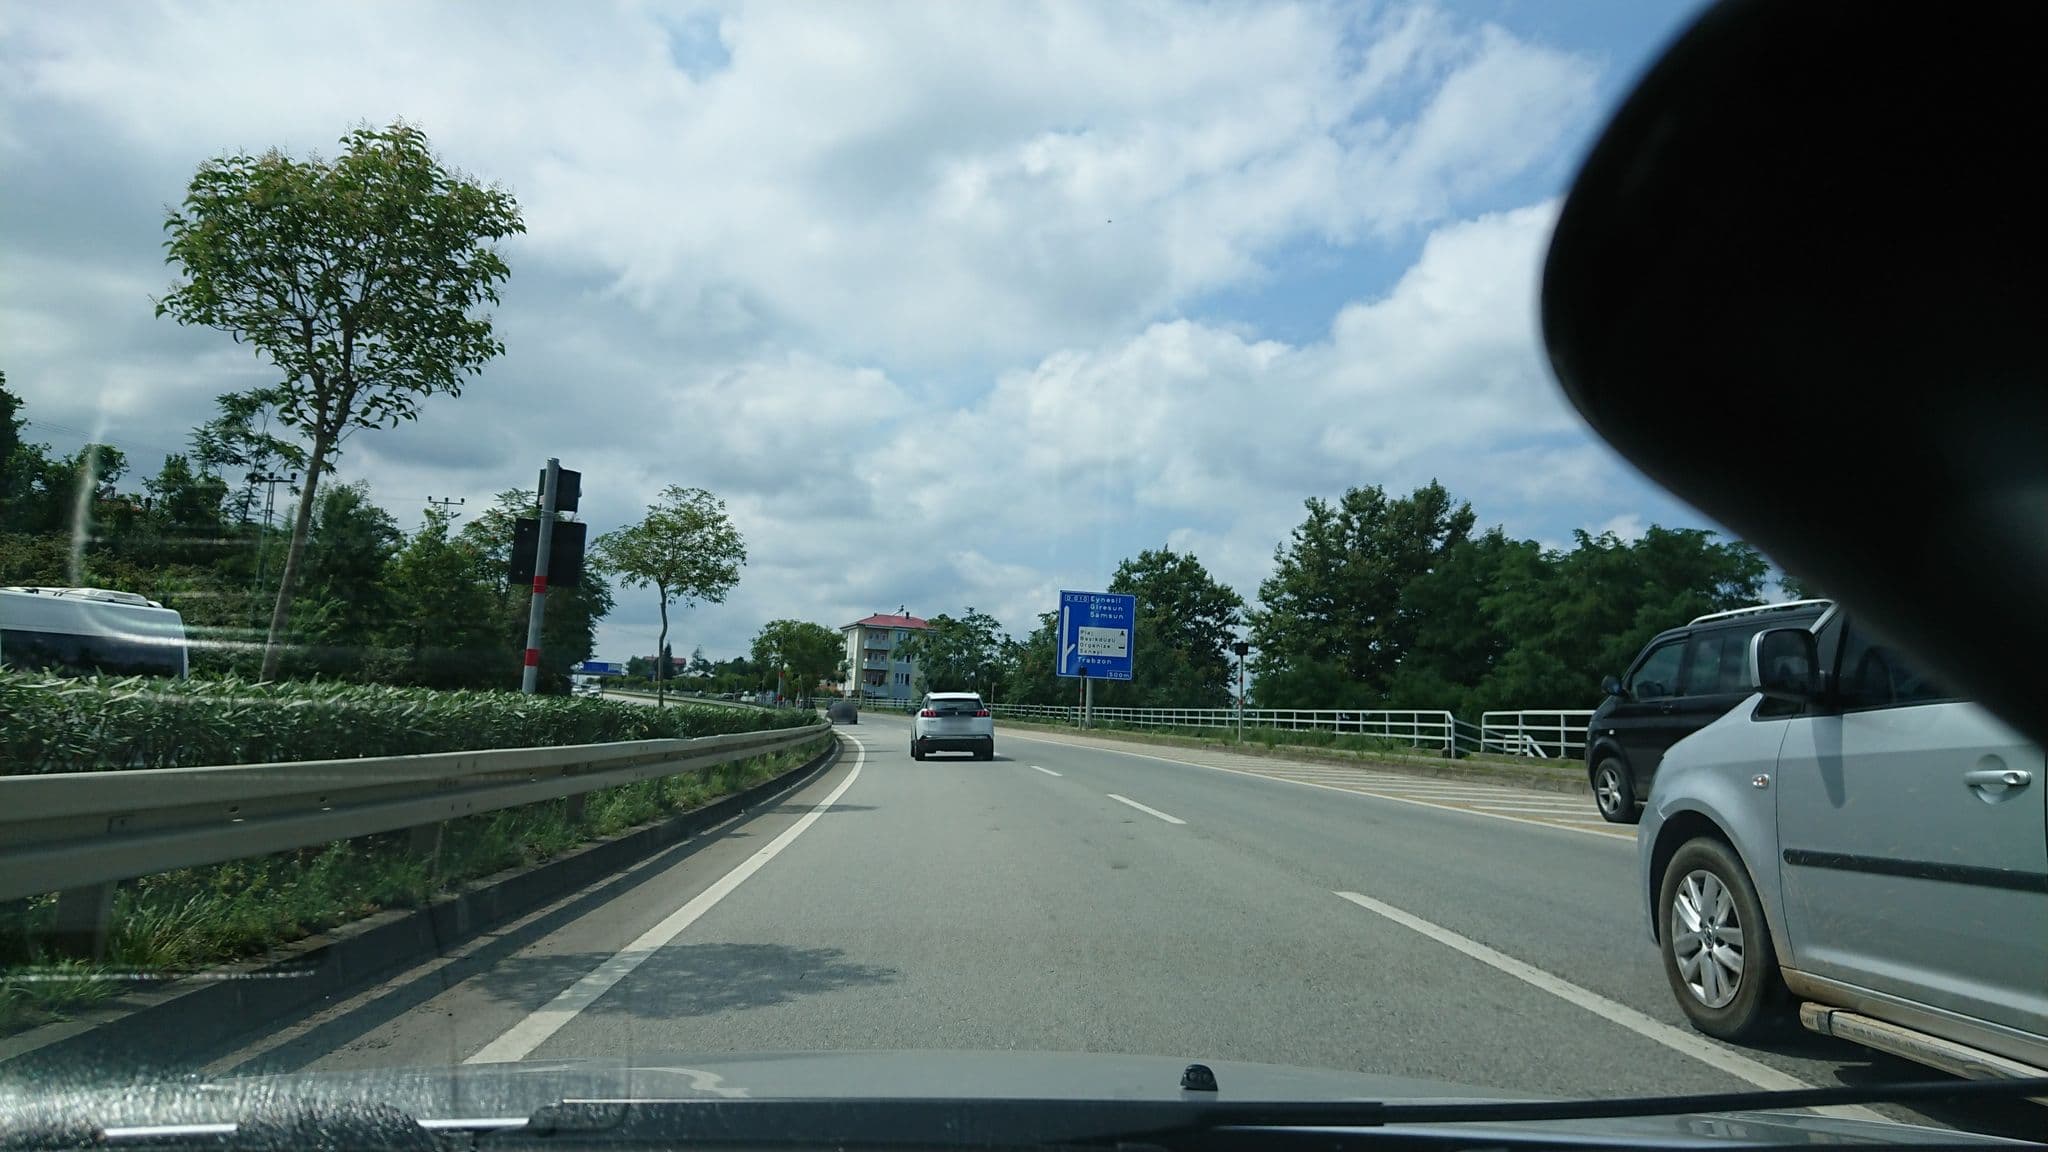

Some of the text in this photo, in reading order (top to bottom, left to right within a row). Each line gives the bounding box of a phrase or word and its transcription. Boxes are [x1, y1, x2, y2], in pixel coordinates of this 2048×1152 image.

[1090, 595, 1121, 604] Eynesil
[1090, 611, 1124, 619] Samsun
[1078, 656, 1112, 665] Trabzon
